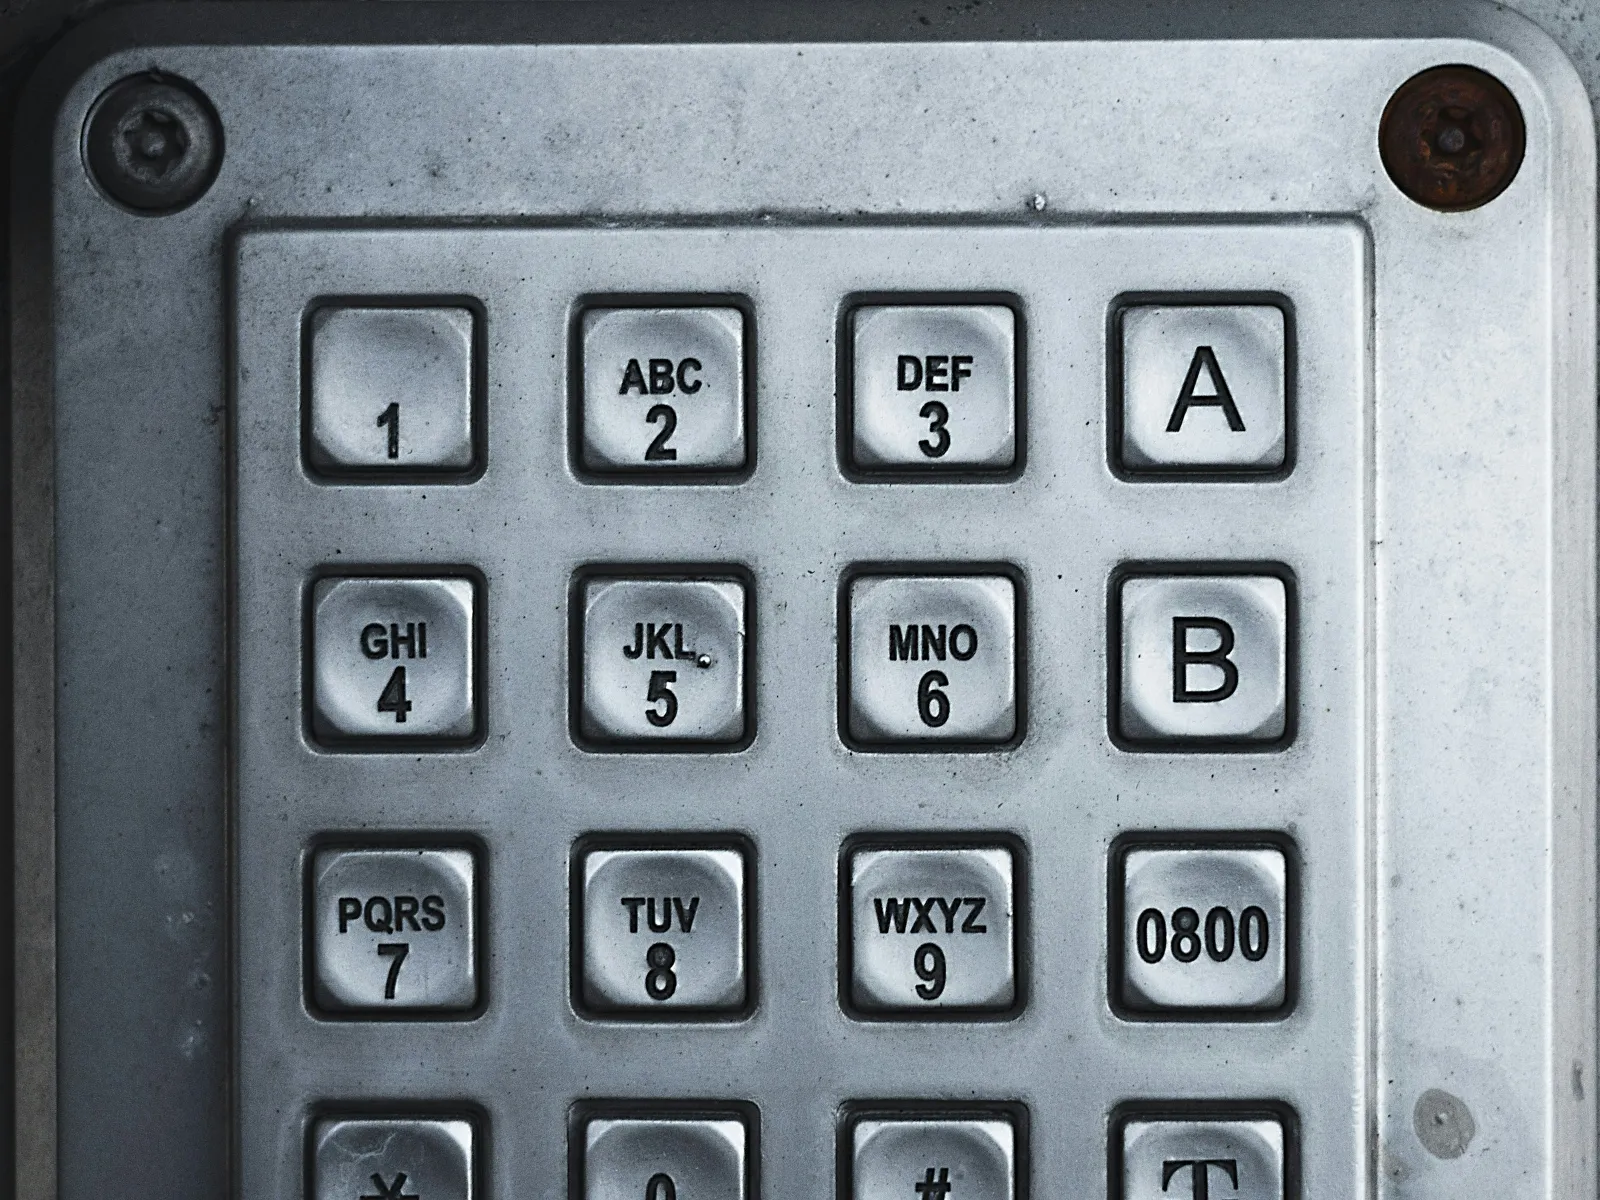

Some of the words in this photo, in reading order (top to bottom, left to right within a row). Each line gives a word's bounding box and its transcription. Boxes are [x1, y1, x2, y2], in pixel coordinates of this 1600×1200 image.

[619, 358, 702, 394] ABC
[897, 355, 973, 392] DEF
[1166, 346, 1245, 432] A
[377, 403, 399, 459] 1
[645, 404, 677, 460] 2
[918, 401, 951, 458] 3
[360, 622, 426, 659] GHI
[623, 623, 694, 659] JKL
[890, 624, 977, 661] MNO
[1173, 617, 1238, 702] B
[377, 666, 411, 722] 4
[646, 670, 677, 726] 5
[918, 670, 950, 726] 6
[339, 895, 445, 935] PQRS
[621, 897, 699, 933] TUV
[874, 898, 986, 933] WXYZ
[1137, 906, 1269, 963] 0800
[378, 943, 409, 999] 7
[645, 943, 676, 1000] 8
[914, 943, 946, 1000] 9
